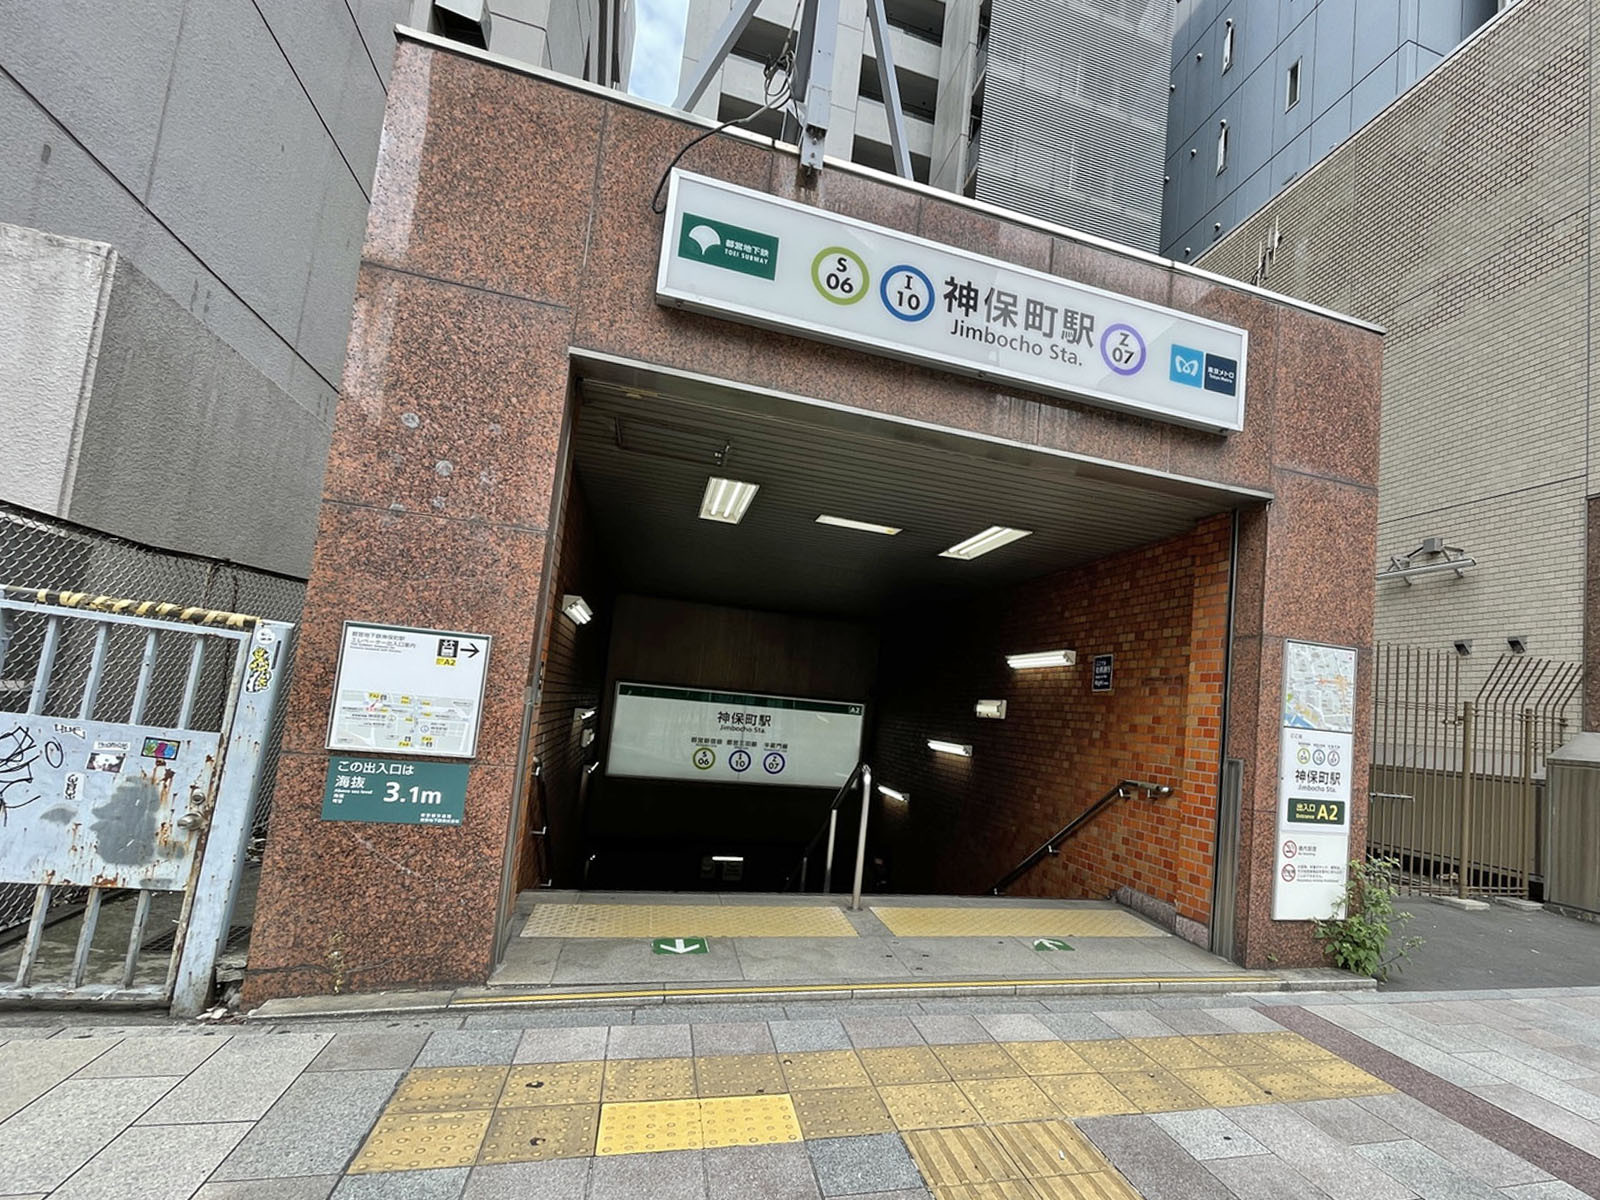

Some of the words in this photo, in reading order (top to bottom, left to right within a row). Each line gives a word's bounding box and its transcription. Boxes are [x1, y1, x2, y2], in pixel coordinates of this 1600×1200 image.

[724, 248, 740, 257] TOEI
[740, 252, 769, 265] SUBWAY
[836, 257, 848, 272] S
[826, 273, 854, 294] 06
[904, 275, 913, 290] I
[897, 291, 920, 310] 10
[943, 276, 1095, 348] 神保町駅
[950, 319, 1043, 356] Jimbocho
[1049, 344, 1083, 367] Sta.
[1119, 332, 1130, 347] Z
[1112, 346, 1135, 365] 07
[443, 658, 457, 666] A2
[717, 711, 772, 727] 神保町駅
[720, 724, 753, 733] Jimbocho
[337, 760, 414, 776] この出入口は
[698, 758, 710, 766] 06
[768, 762, 780, 770] 07
[334, 774, 366, 789] 海抜
[1295, 769, 1341, 786] 神保町駅
[383, 781, 442, 805] 3.1m
[1316, 804, 1338, 821] A2
